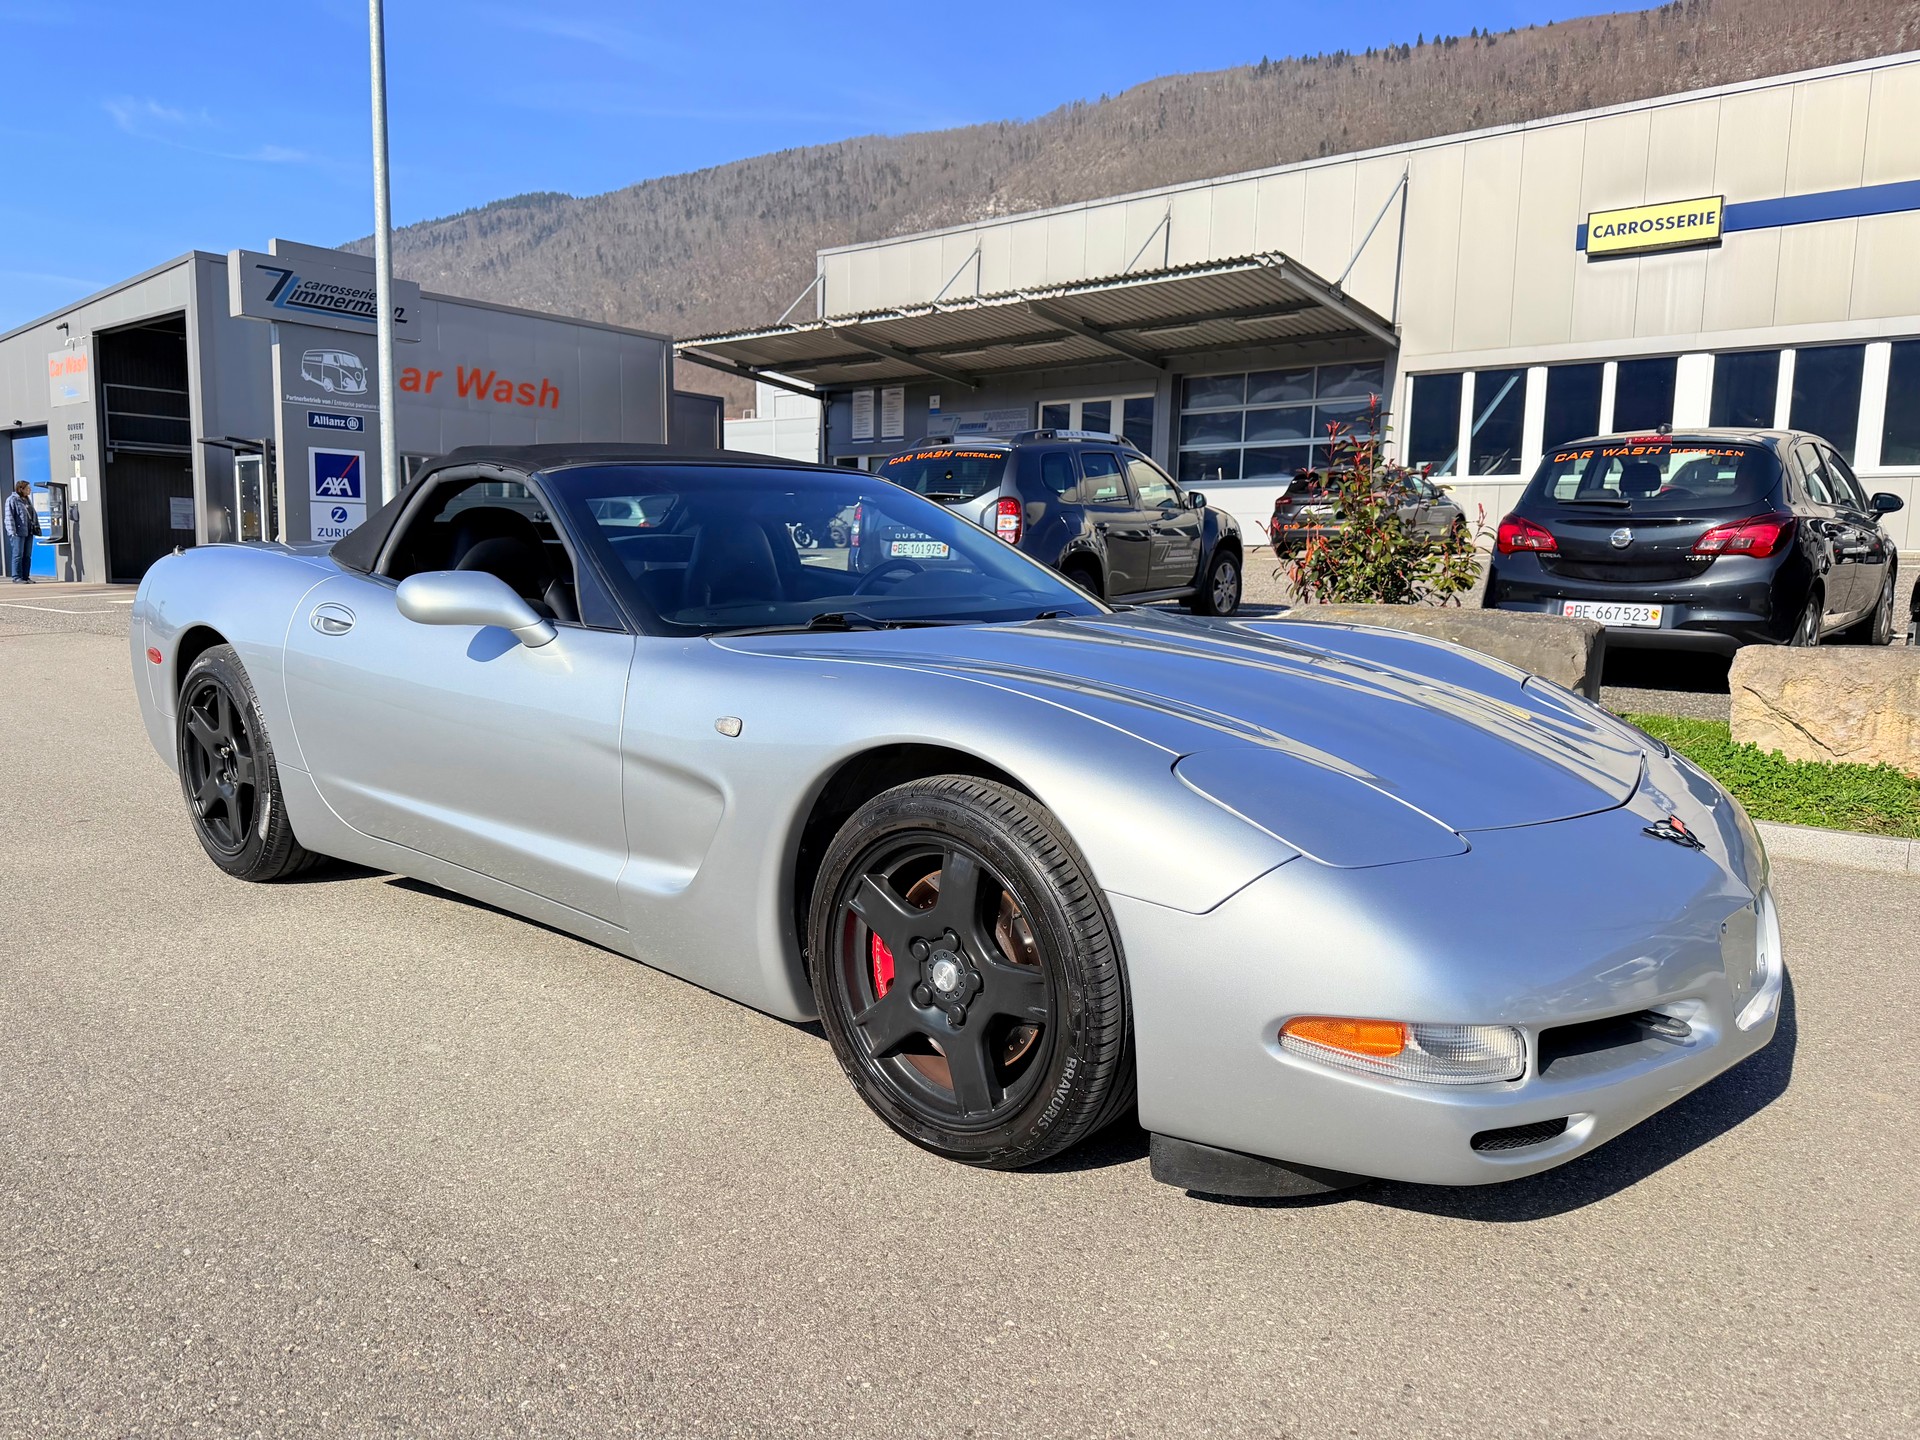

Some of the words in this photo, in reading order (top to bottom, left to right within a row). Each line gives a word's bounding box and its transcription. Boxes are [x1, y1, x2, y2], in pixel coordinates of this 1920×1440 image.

[1593, 211, 1716, 238] CARROSSERIE
[304, 279, 377, 300] carrosserie
[400, 367, 443, 394] ar
[456, 365, 560, 409] Wash
[67, 423, 85, 431] OUVERT
[313, 415, 346, 427] Allianz
[69, 433, 83, 441] OFFEN
[889, 454, 914, 465] CAR
[916, 450, 954, 460] WASH
[955, 451, 1002, 459] PIETERLEN
[1554, 450, 1594, 463] CAR
[1602, 446, 1663, 457] WASH
[1668, 448, 1745, 457] PIETERLEN
[316, 477, 353, 496] AXA
[1037, 1056, 1077, 1130] BRAVURIS
